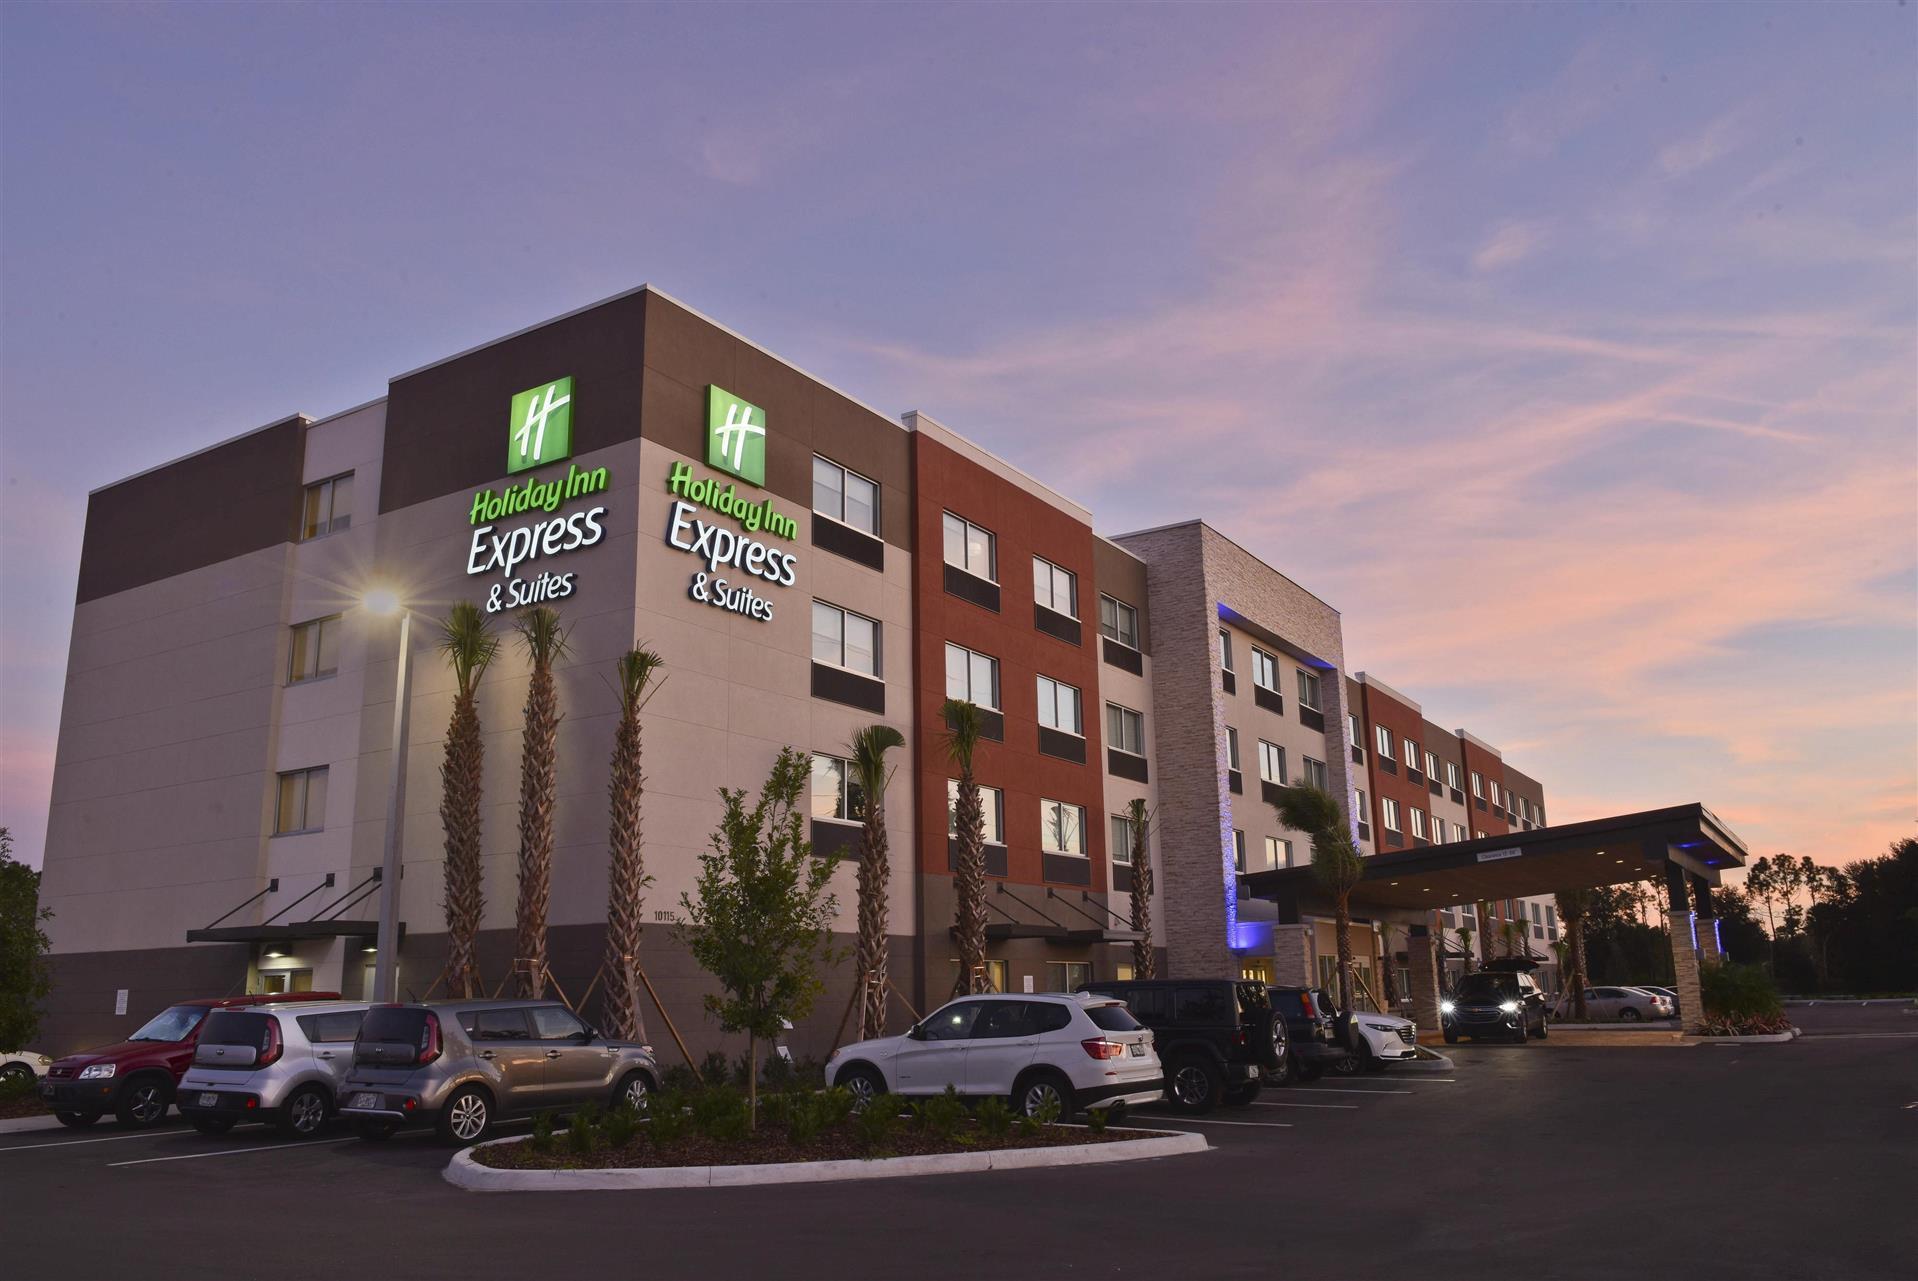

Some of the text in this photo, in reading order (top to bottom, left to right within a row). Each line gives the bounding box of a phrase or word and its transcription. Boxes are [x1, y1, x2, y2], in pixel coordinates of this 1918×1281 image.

[470, 464, 607, 525] Holiday Inn
[670, 461, 798, 541] Holiday Inn
[467, 506, 604, 578] Express
[669, 501, 797, 587] Express
[486, 571, 574, 613] & Suites
[692, 571, 774, 621] & Suites
[654, 910, 675, 922] 10115
